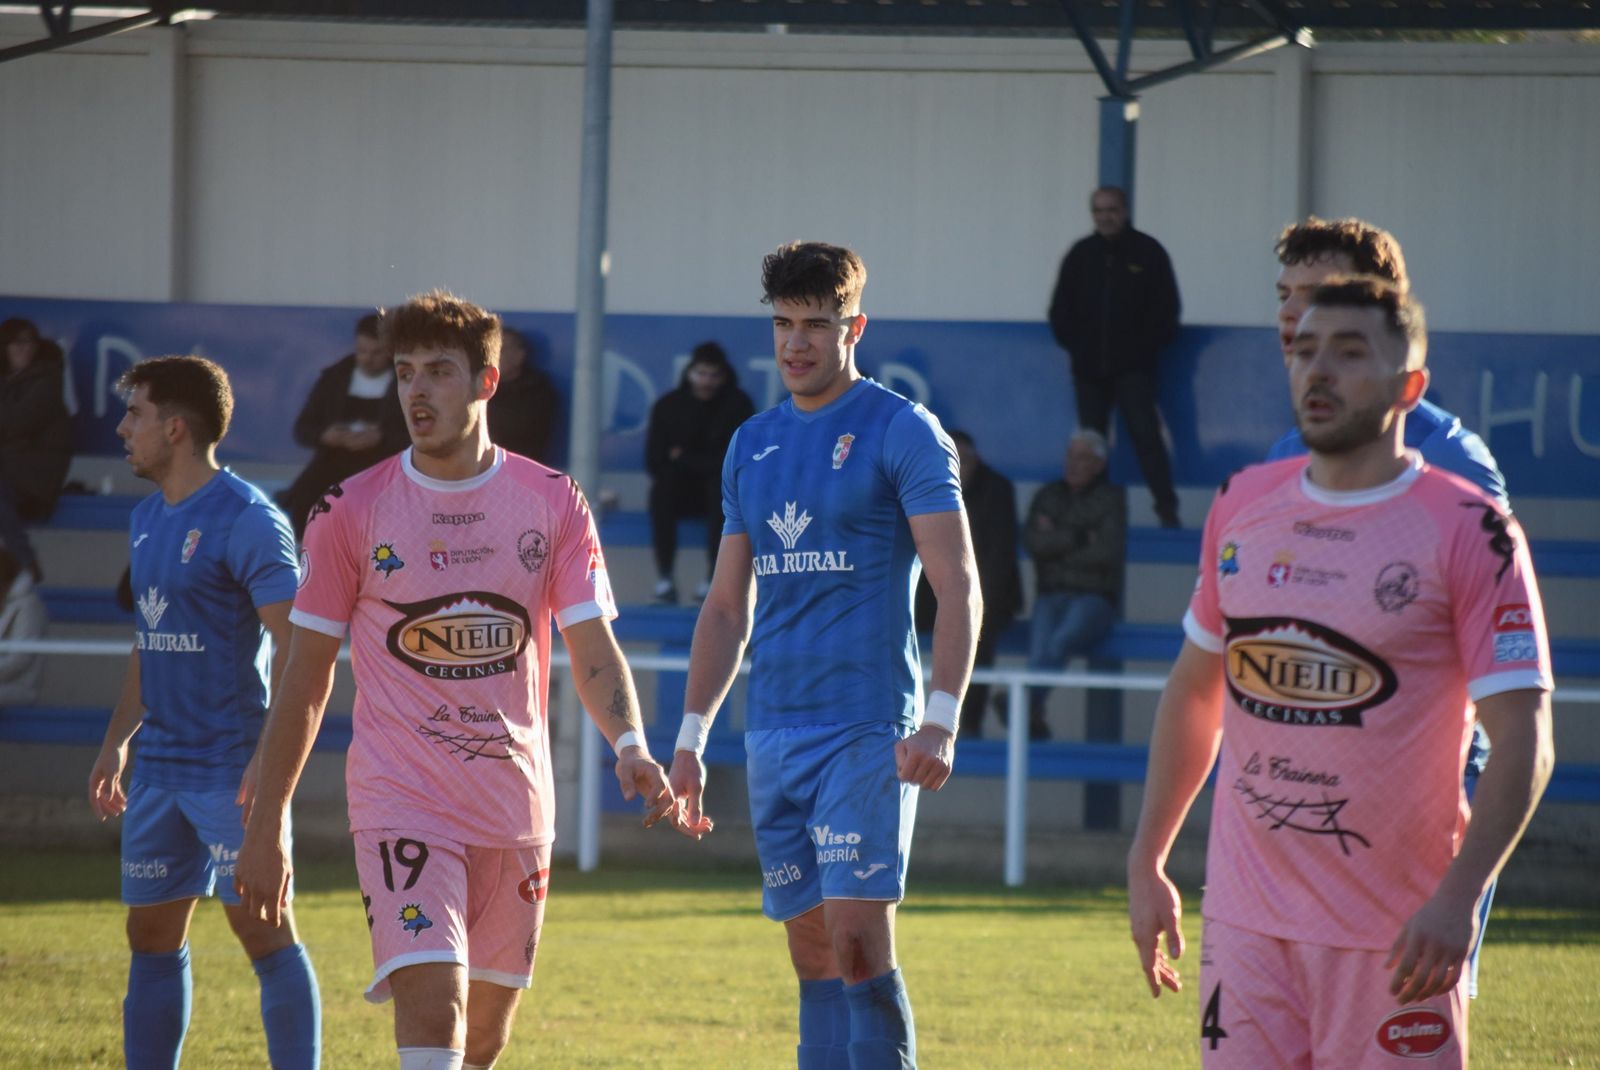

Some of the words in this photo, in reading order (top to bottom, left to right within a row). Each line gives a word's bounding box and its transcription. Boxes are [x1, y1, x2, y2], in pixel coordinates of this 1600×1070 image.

[432, 512, 485, 526] Kappa
[752, 553, 780, 576] AJA
[782, 550, 854, 574] RURAL
[147, 631, 205, 652] RURAL
[412, 621, 515, 653] NIETO
[423, 659, 507, 679] CECINAS
[1234, 648, 1360, 696] NIETO
[427, 703, 450, 722] La
[1240, 697, 1343, 725] CECINAS
[813, 824, 862, 847] Viso
[208, 842, 239, 863] Vis
[816, 846, 860, 865] ADERÍA
[121, 857, 168, 880] recicla
[378, 837, 429, 893] 19
[763, 862, 802, 889] ecicla
[1387, 1021, 1443, 1041] Dulma
